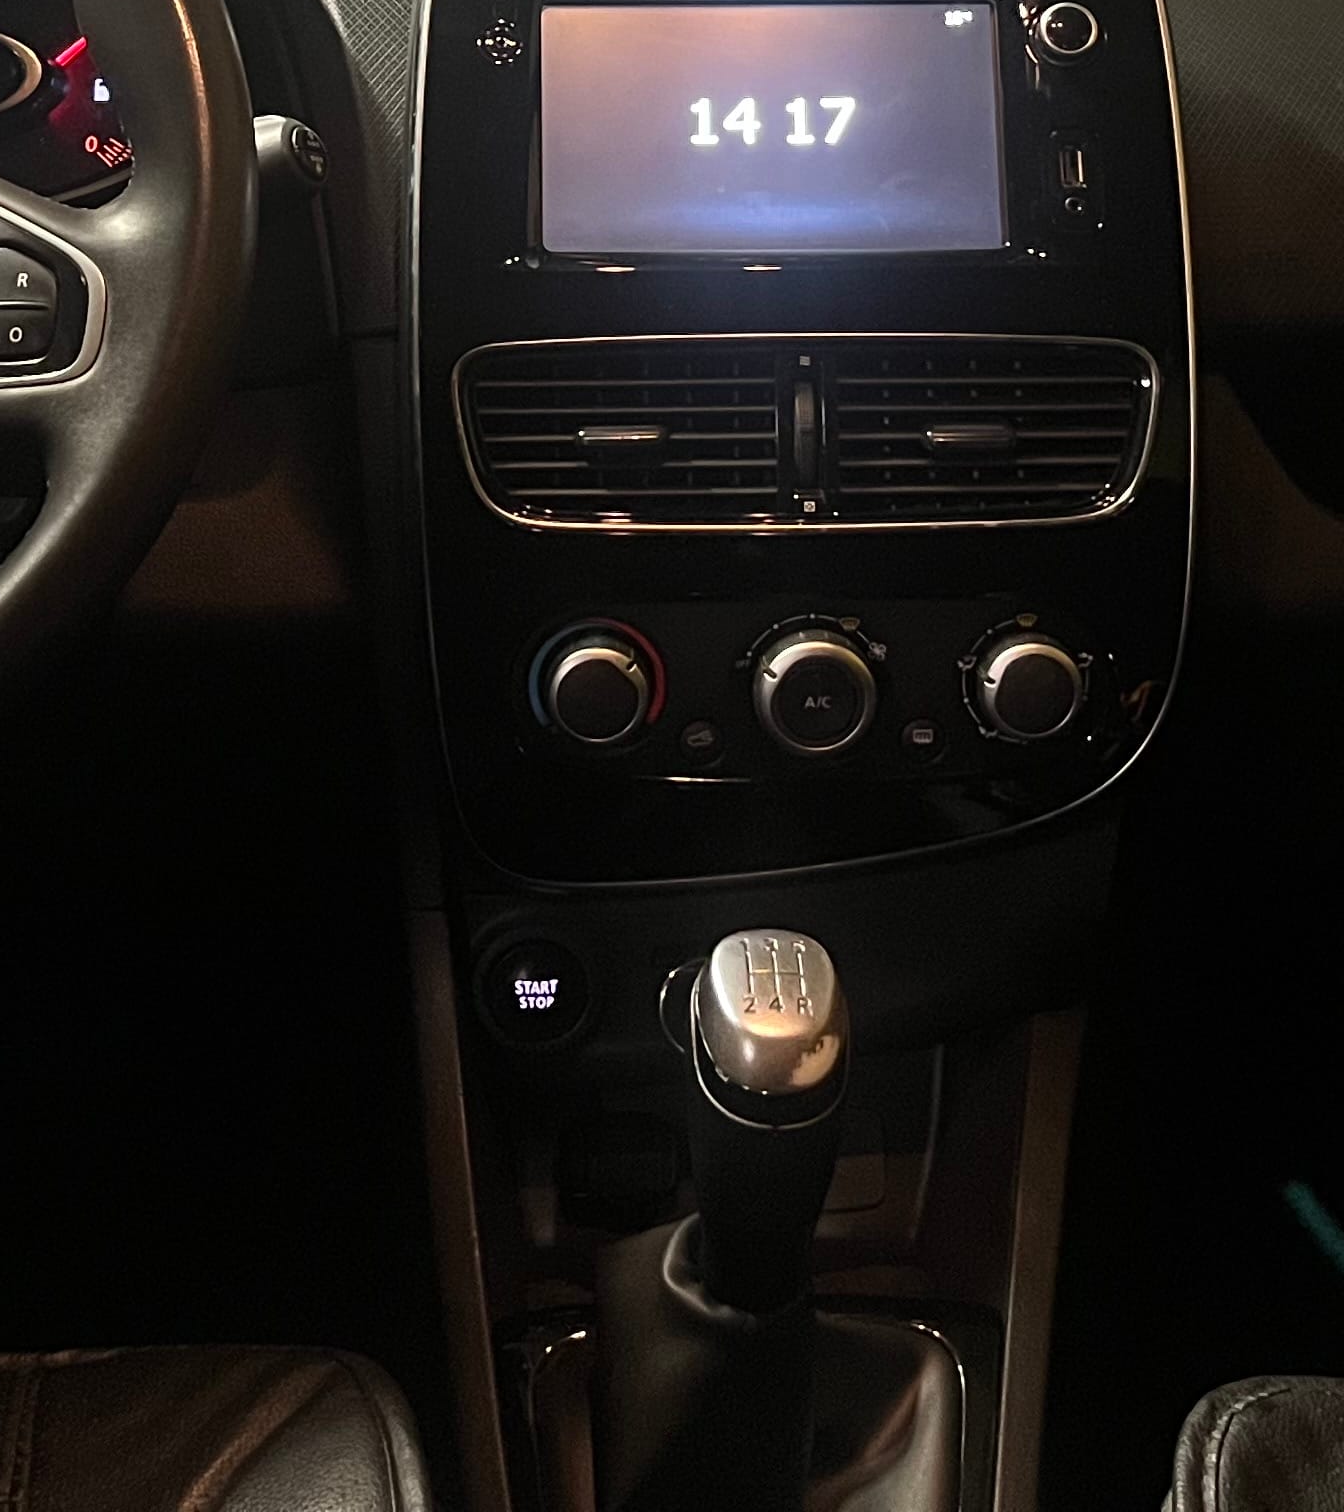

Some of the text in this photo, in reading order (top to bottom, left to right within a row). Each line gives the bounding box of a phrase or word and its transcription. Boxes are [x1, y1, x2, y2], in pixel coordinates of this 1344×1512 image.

[689, 96, 856, 145] 14 17
[16, 272, 29, 288] R
[804, 695, 832, 709] A/C
[763, 937, 779, 952] 3
[514, 978, 559, 995] START
[519, 995, 555, 1009] STOP
[742, 995, 814, 1017] 2 4 R
